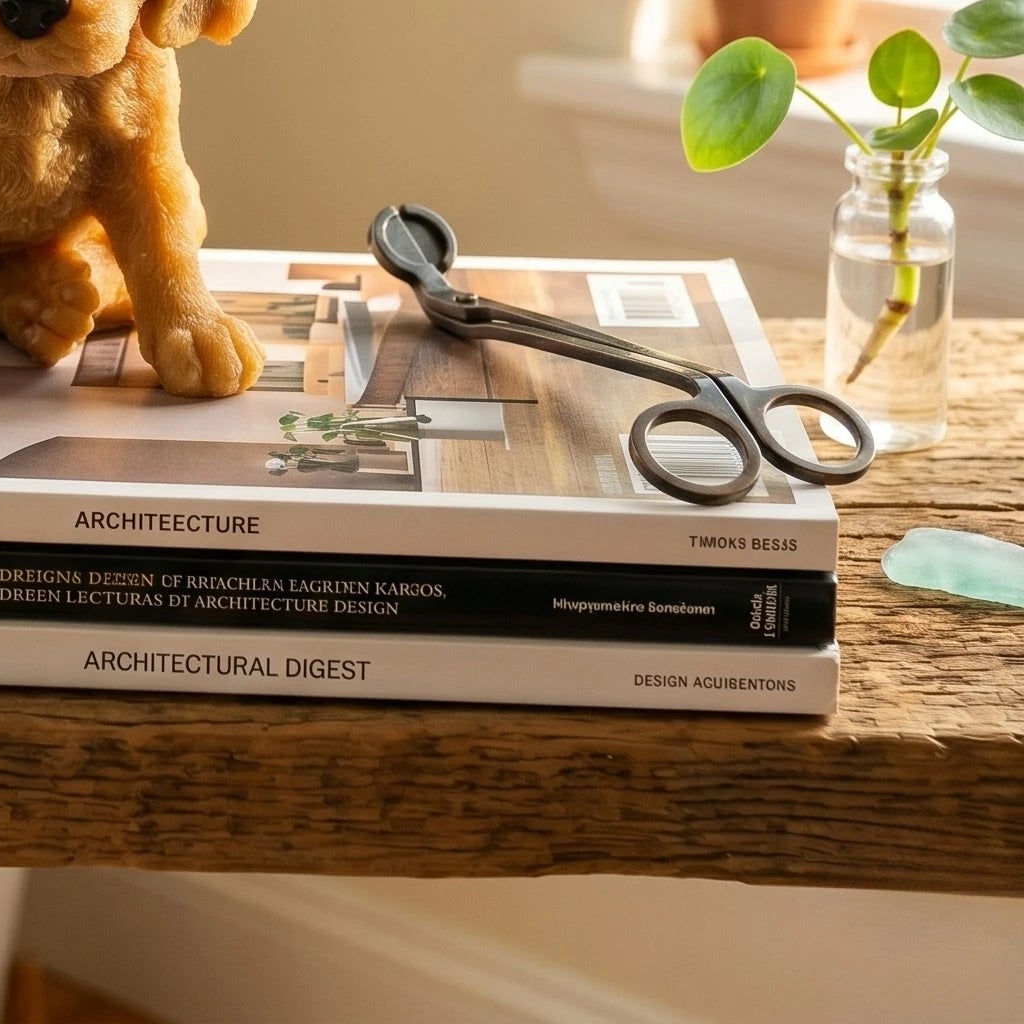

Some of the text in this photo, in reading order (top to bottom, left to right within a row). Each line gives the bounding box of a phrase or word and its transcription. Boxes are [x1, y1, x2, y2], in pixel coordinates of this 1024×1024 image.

[74, 511, 260, 534] ARCHITEECTURE
[0, 587, 61, 602] DREEN
[66, 590, 163, 606] LECTURAS
[194, 595, 328, 612] ARCHITECTURE
[334, 600, 399, 615] DESIGN
[83, 651, 371, 680] ARCHITECTURAL DIGEST
[634, 674, 687, 688] DESIGN
